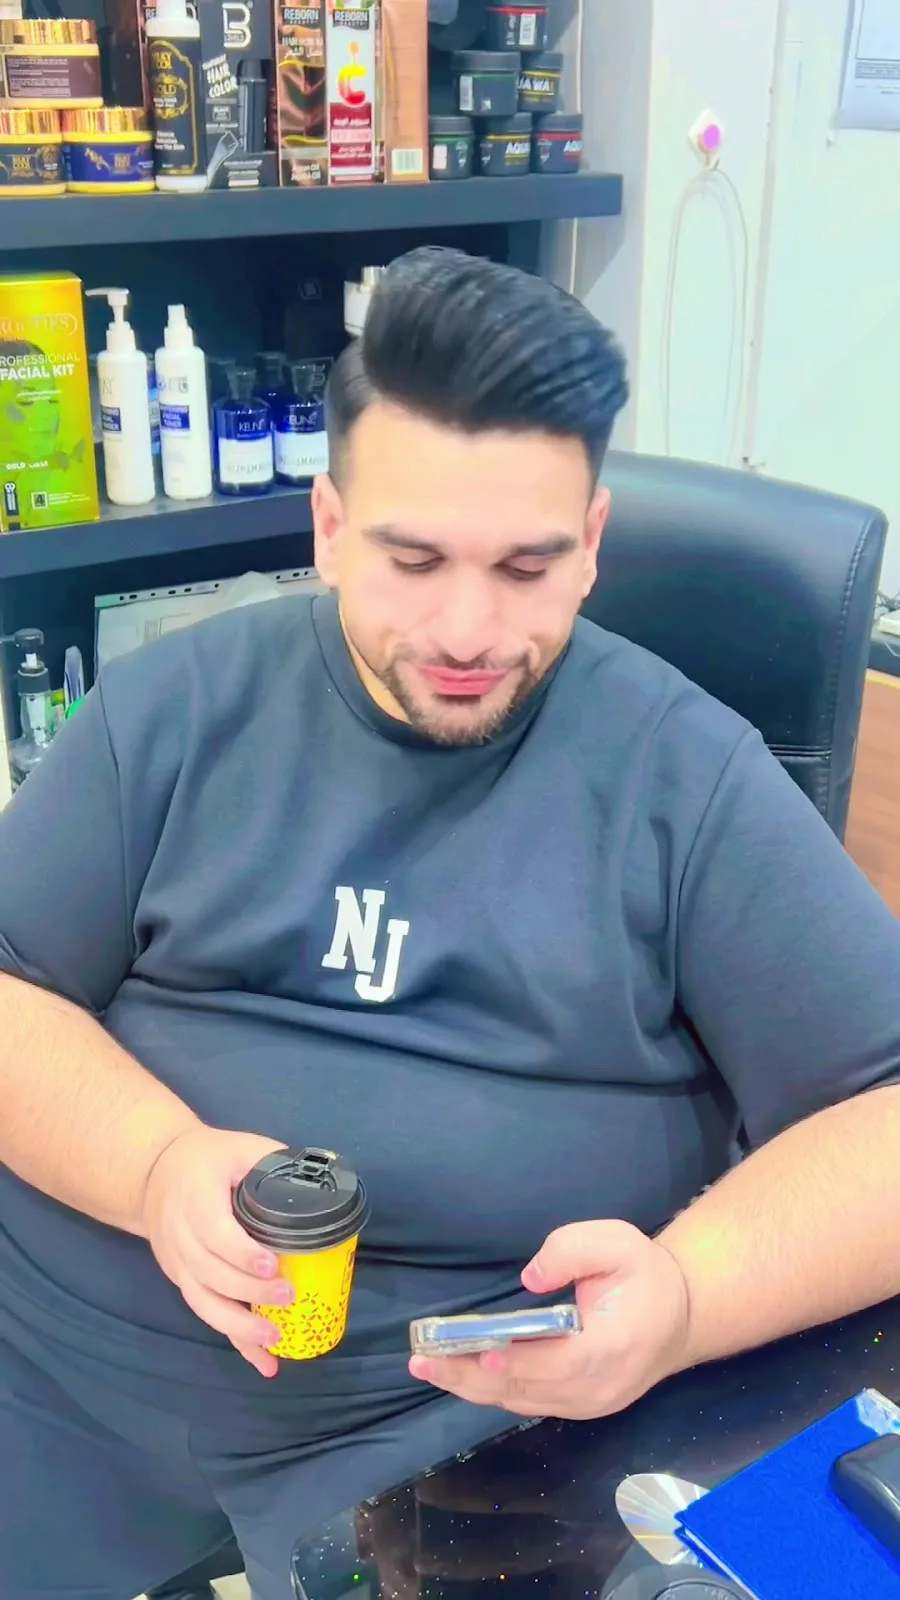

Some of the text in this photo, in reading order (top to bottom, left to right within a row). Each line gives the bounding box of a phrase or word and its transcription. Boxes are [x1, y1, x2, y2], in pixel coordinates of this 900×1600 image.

[284, 8, 319, 20] REBORN
[334, 11, 368, 21] REBORN
[206, 62, 231, 84] HAIR
[208, 75, 238, 99] COLOR
[0, 352, 81, 367] ROFESSIONAL
[0, 364, 76, 380] FACIAL KIT
